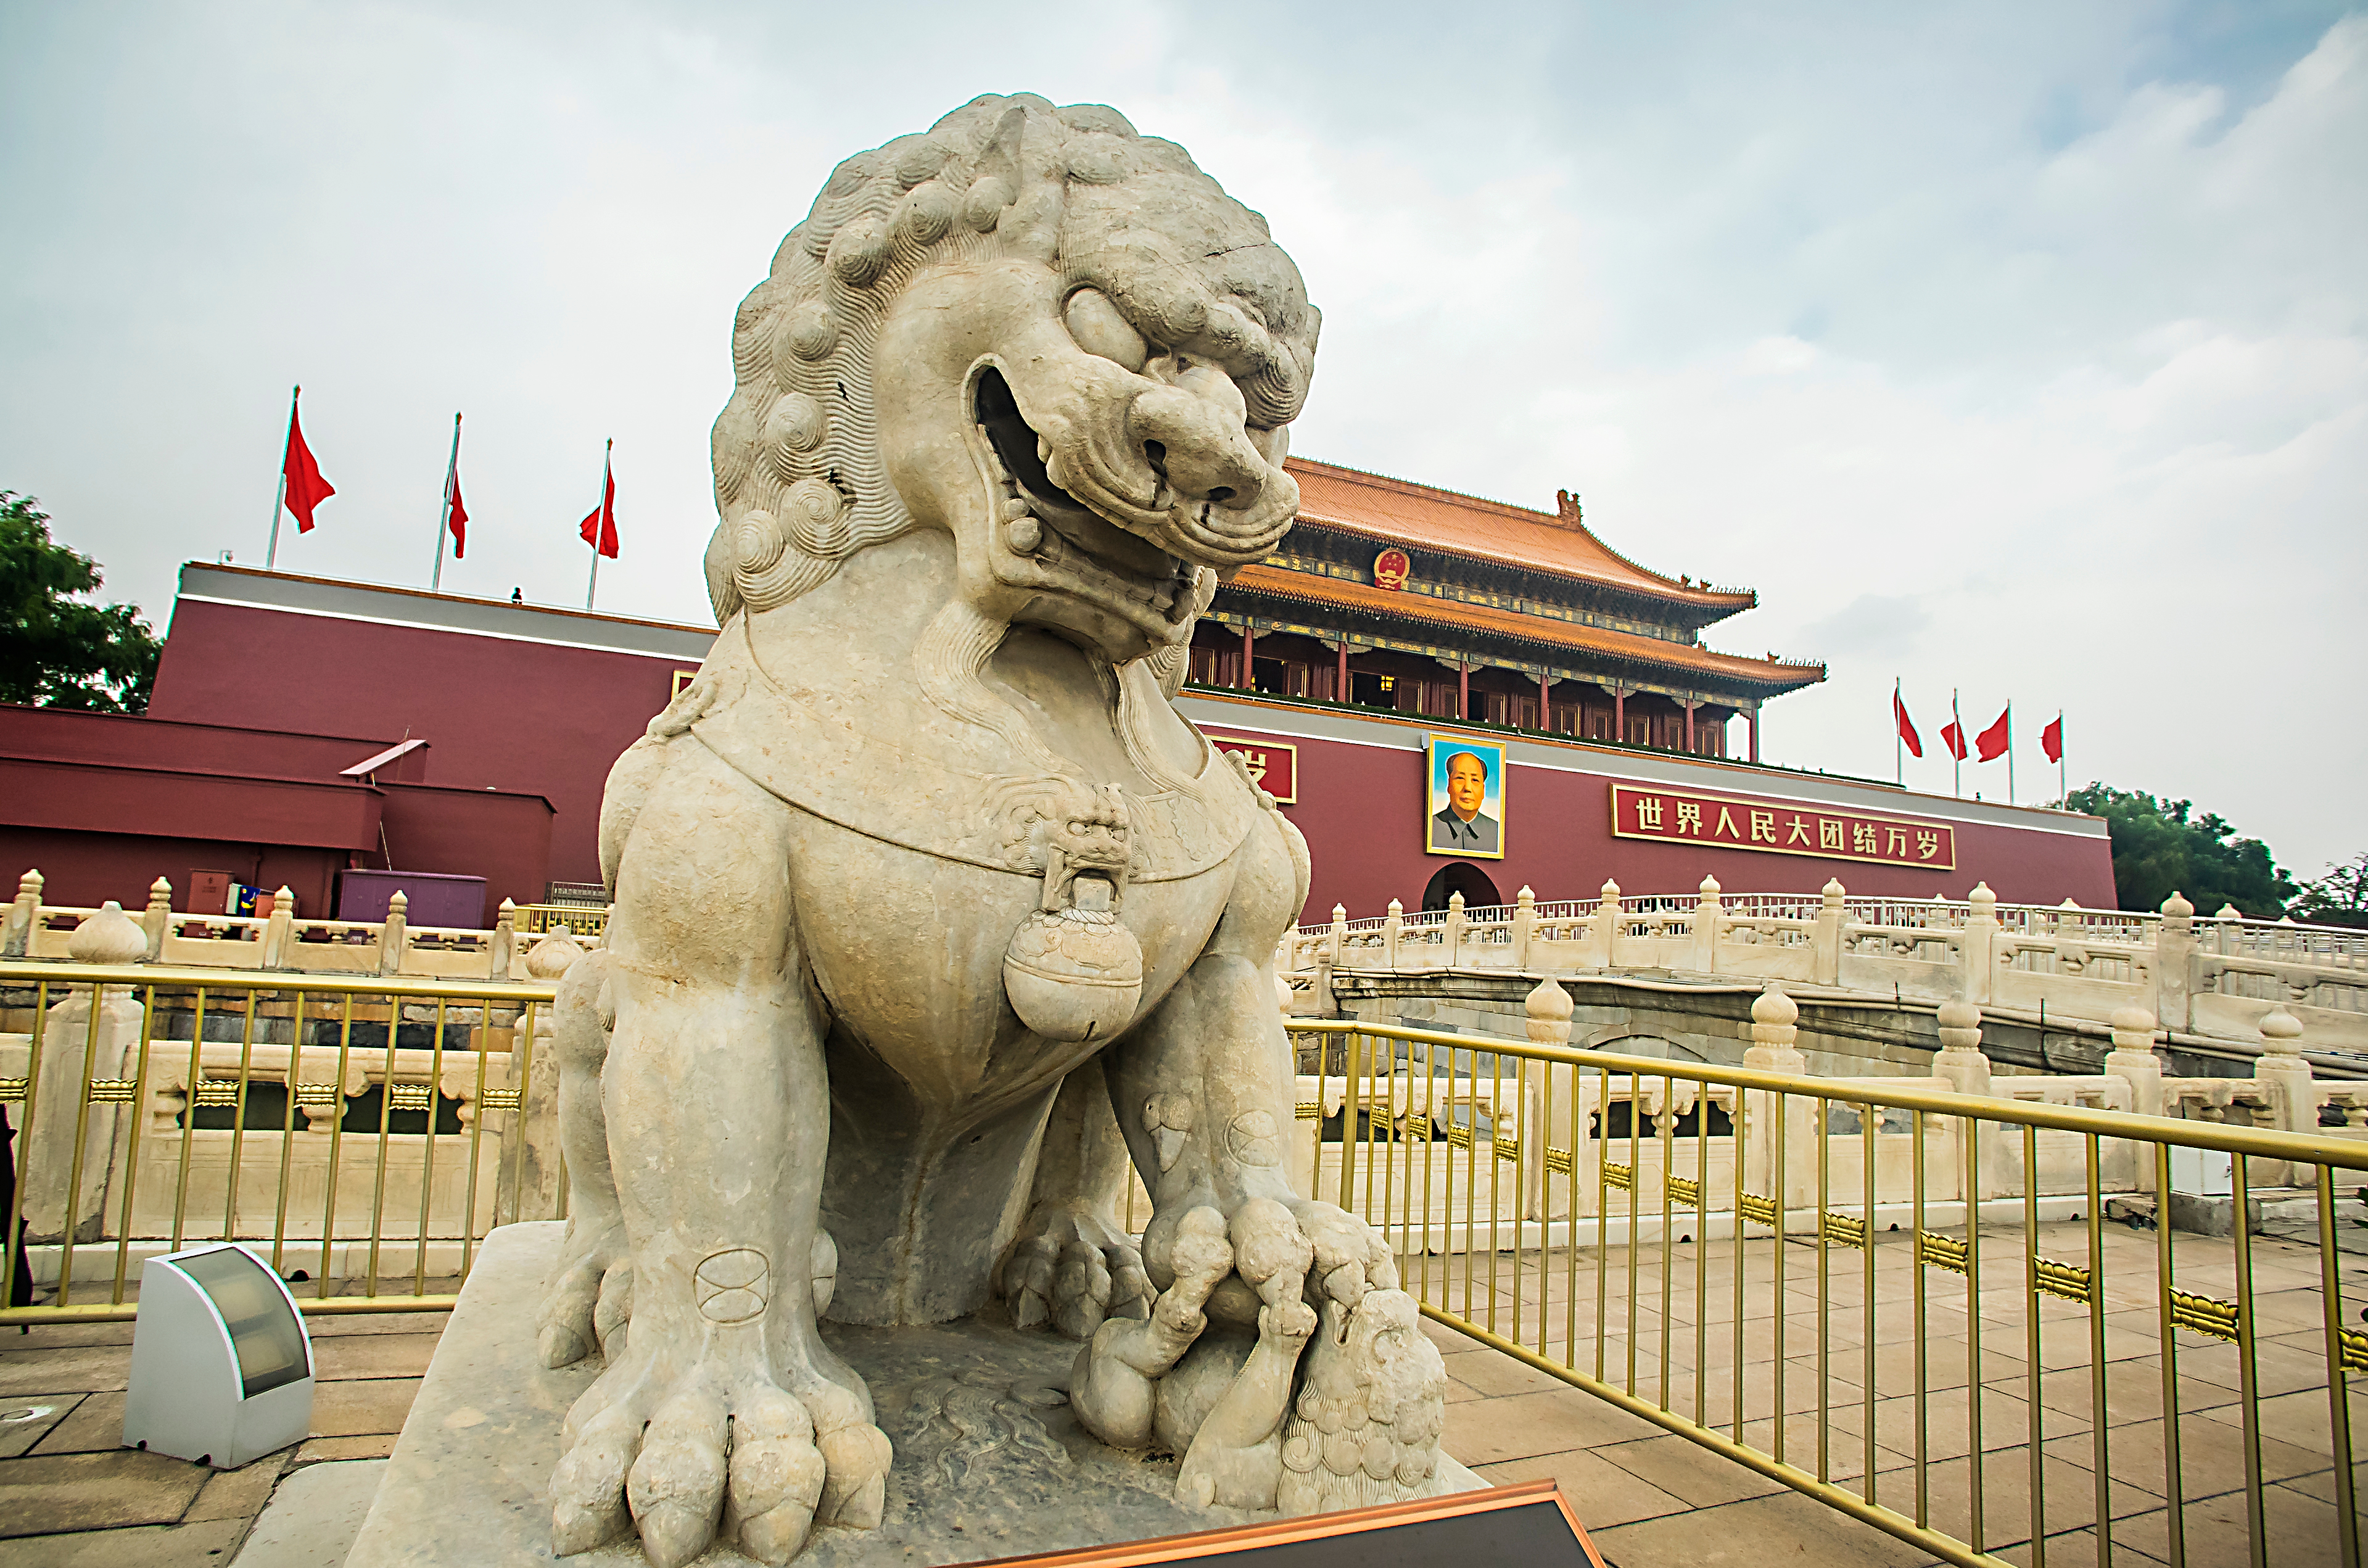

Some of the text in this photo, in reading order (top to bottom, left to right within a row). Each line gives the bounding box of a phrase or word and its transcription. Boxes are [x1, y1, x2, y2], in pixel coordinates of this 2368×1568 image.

[1636, 798, 1938, 859] 世界人民大团结万岁
